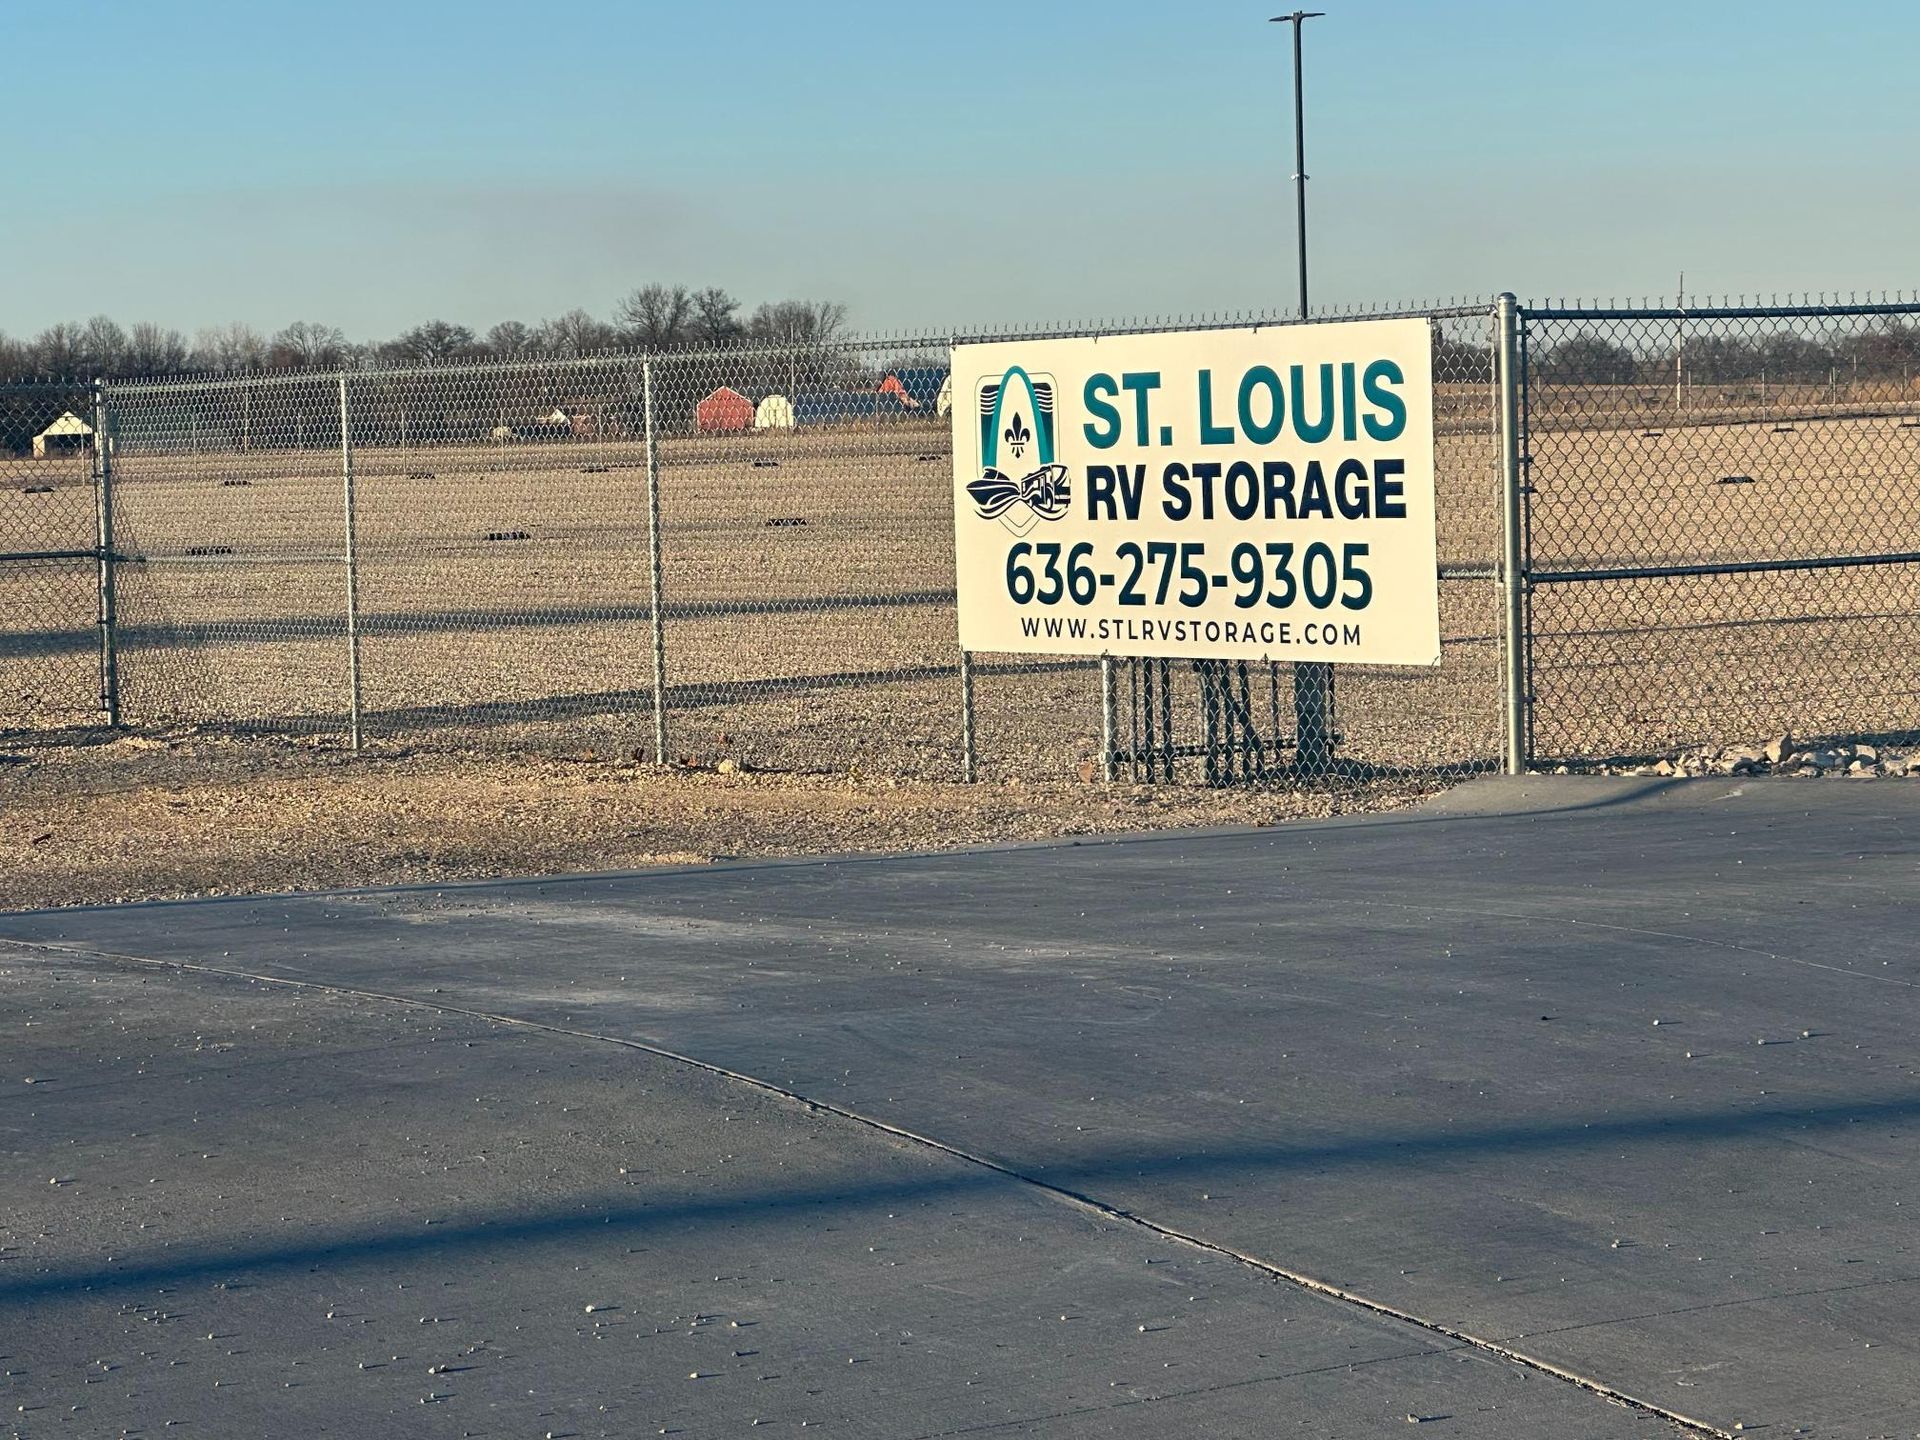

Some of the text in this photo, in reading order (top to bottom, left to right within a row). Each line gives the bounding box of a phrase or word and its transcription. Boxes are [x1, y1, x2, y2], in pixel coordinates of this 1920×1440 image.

[1083, 359, 1407, 449] ST. LOUIS
[1087, 459, 1407, 521] RV STORAGE
[1006, 541, 1373, 611] 636-275-9305
[1021, 617, 1361, 646] WWW.STLRVSTORAGE.COM
